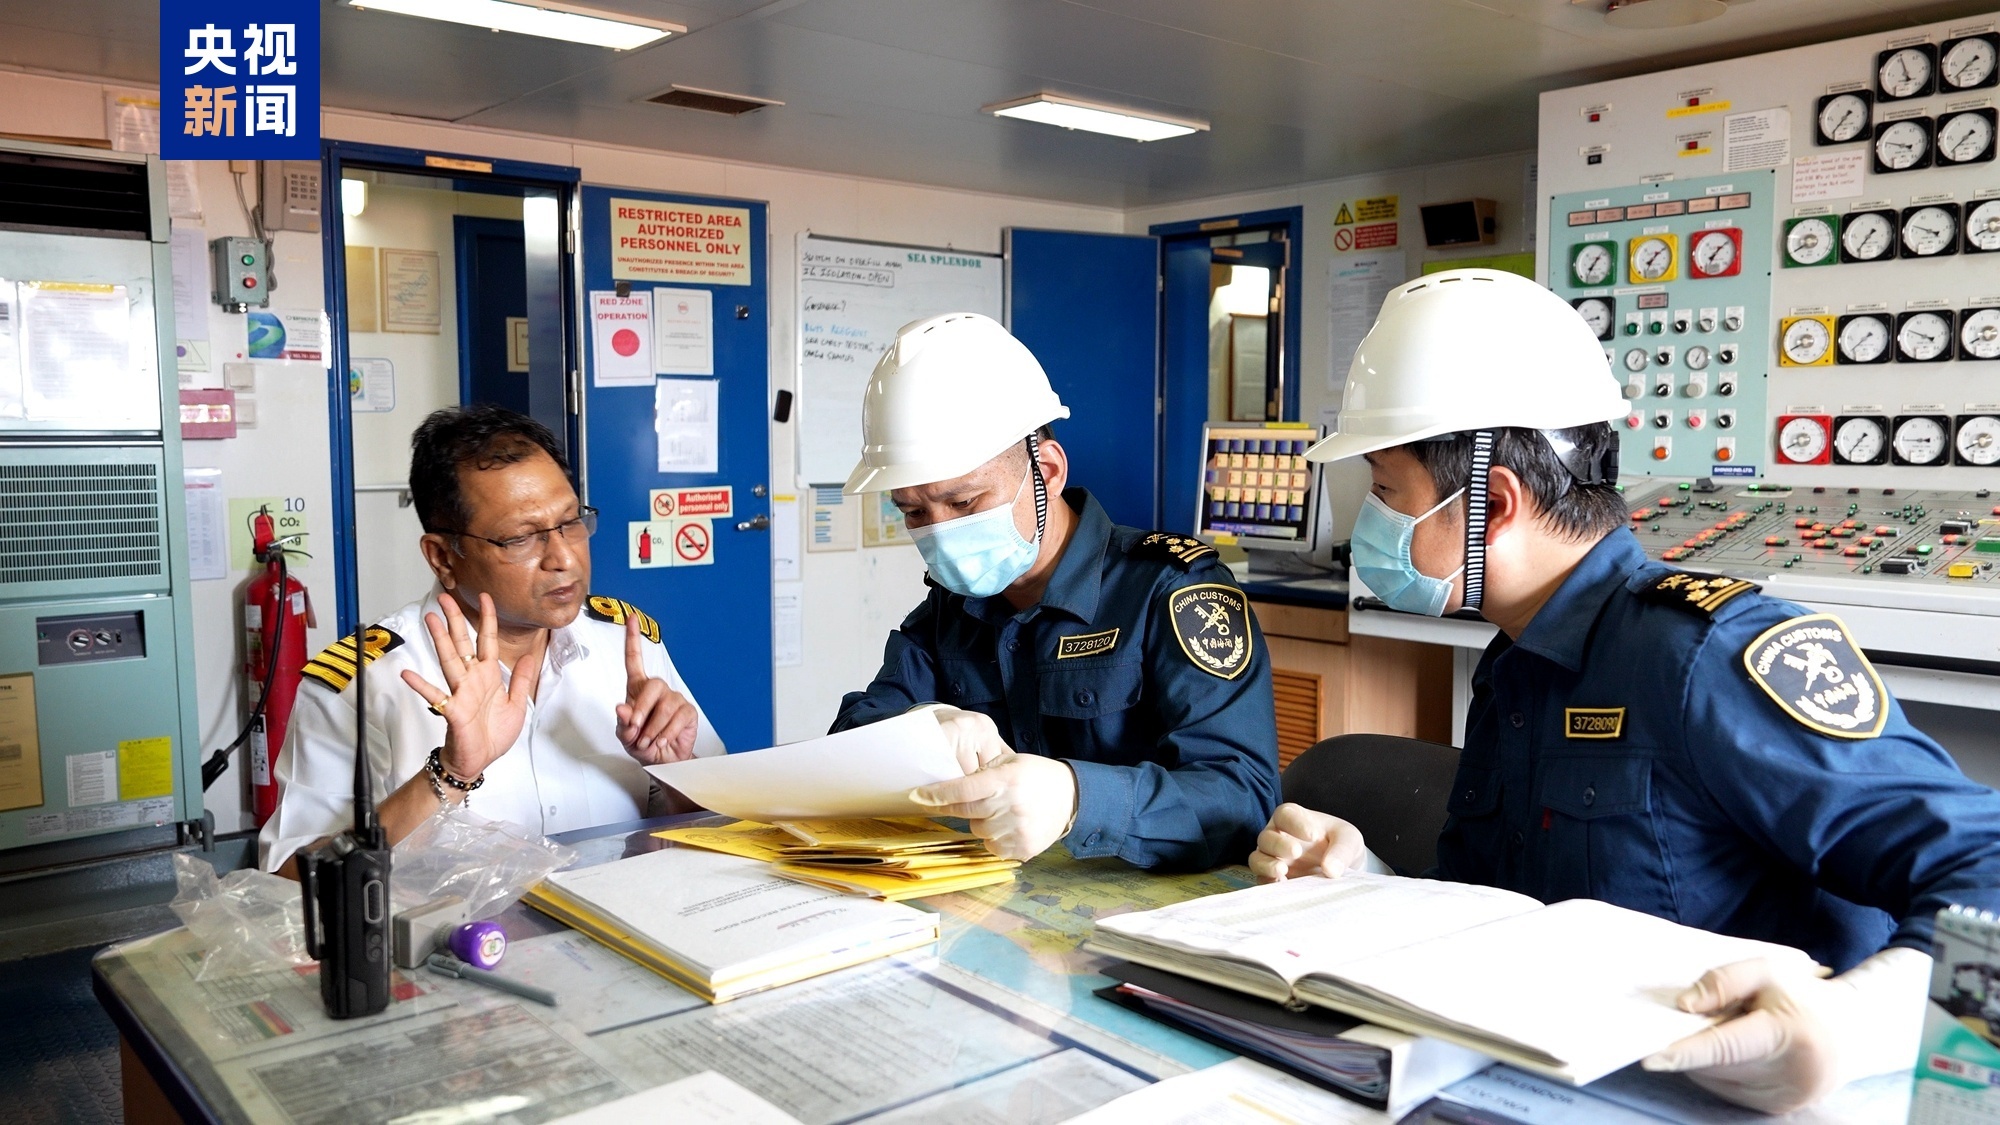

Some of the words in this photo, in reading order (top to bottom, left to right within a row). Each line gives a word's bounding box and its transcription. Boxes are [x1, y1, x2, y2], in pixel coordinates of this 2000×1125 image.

[618, 207, 703, 224] RESTRICTED
[707, 215, 742, 227] AREA
[638, 224, 724, 240] AUTHORIZED
[620, 237, 702, 253] PERSONNEL
[706, 243, 741, 255] ONLY
[907, 253, 927, 263] SEA
[930, 255, 982, 268] SPLENDOR
[285, 498, 305, 512] 10
[685, 493, 722, 503] Authorised
[680, 504, 713, 513] personnel
[714, 502, 728, 512] only
[1174, 594, 1200, 613] CHINA
[1199, 591, 1242, 612] CUSTOMS
[1065, 636, 1111, 653] 3728120
[1757, 643, 1785, 676] CHINA
[1779, 627, 1843, 649] CUSTOMS
[1495, 1074, 1574, 1104] SPLENDOR
